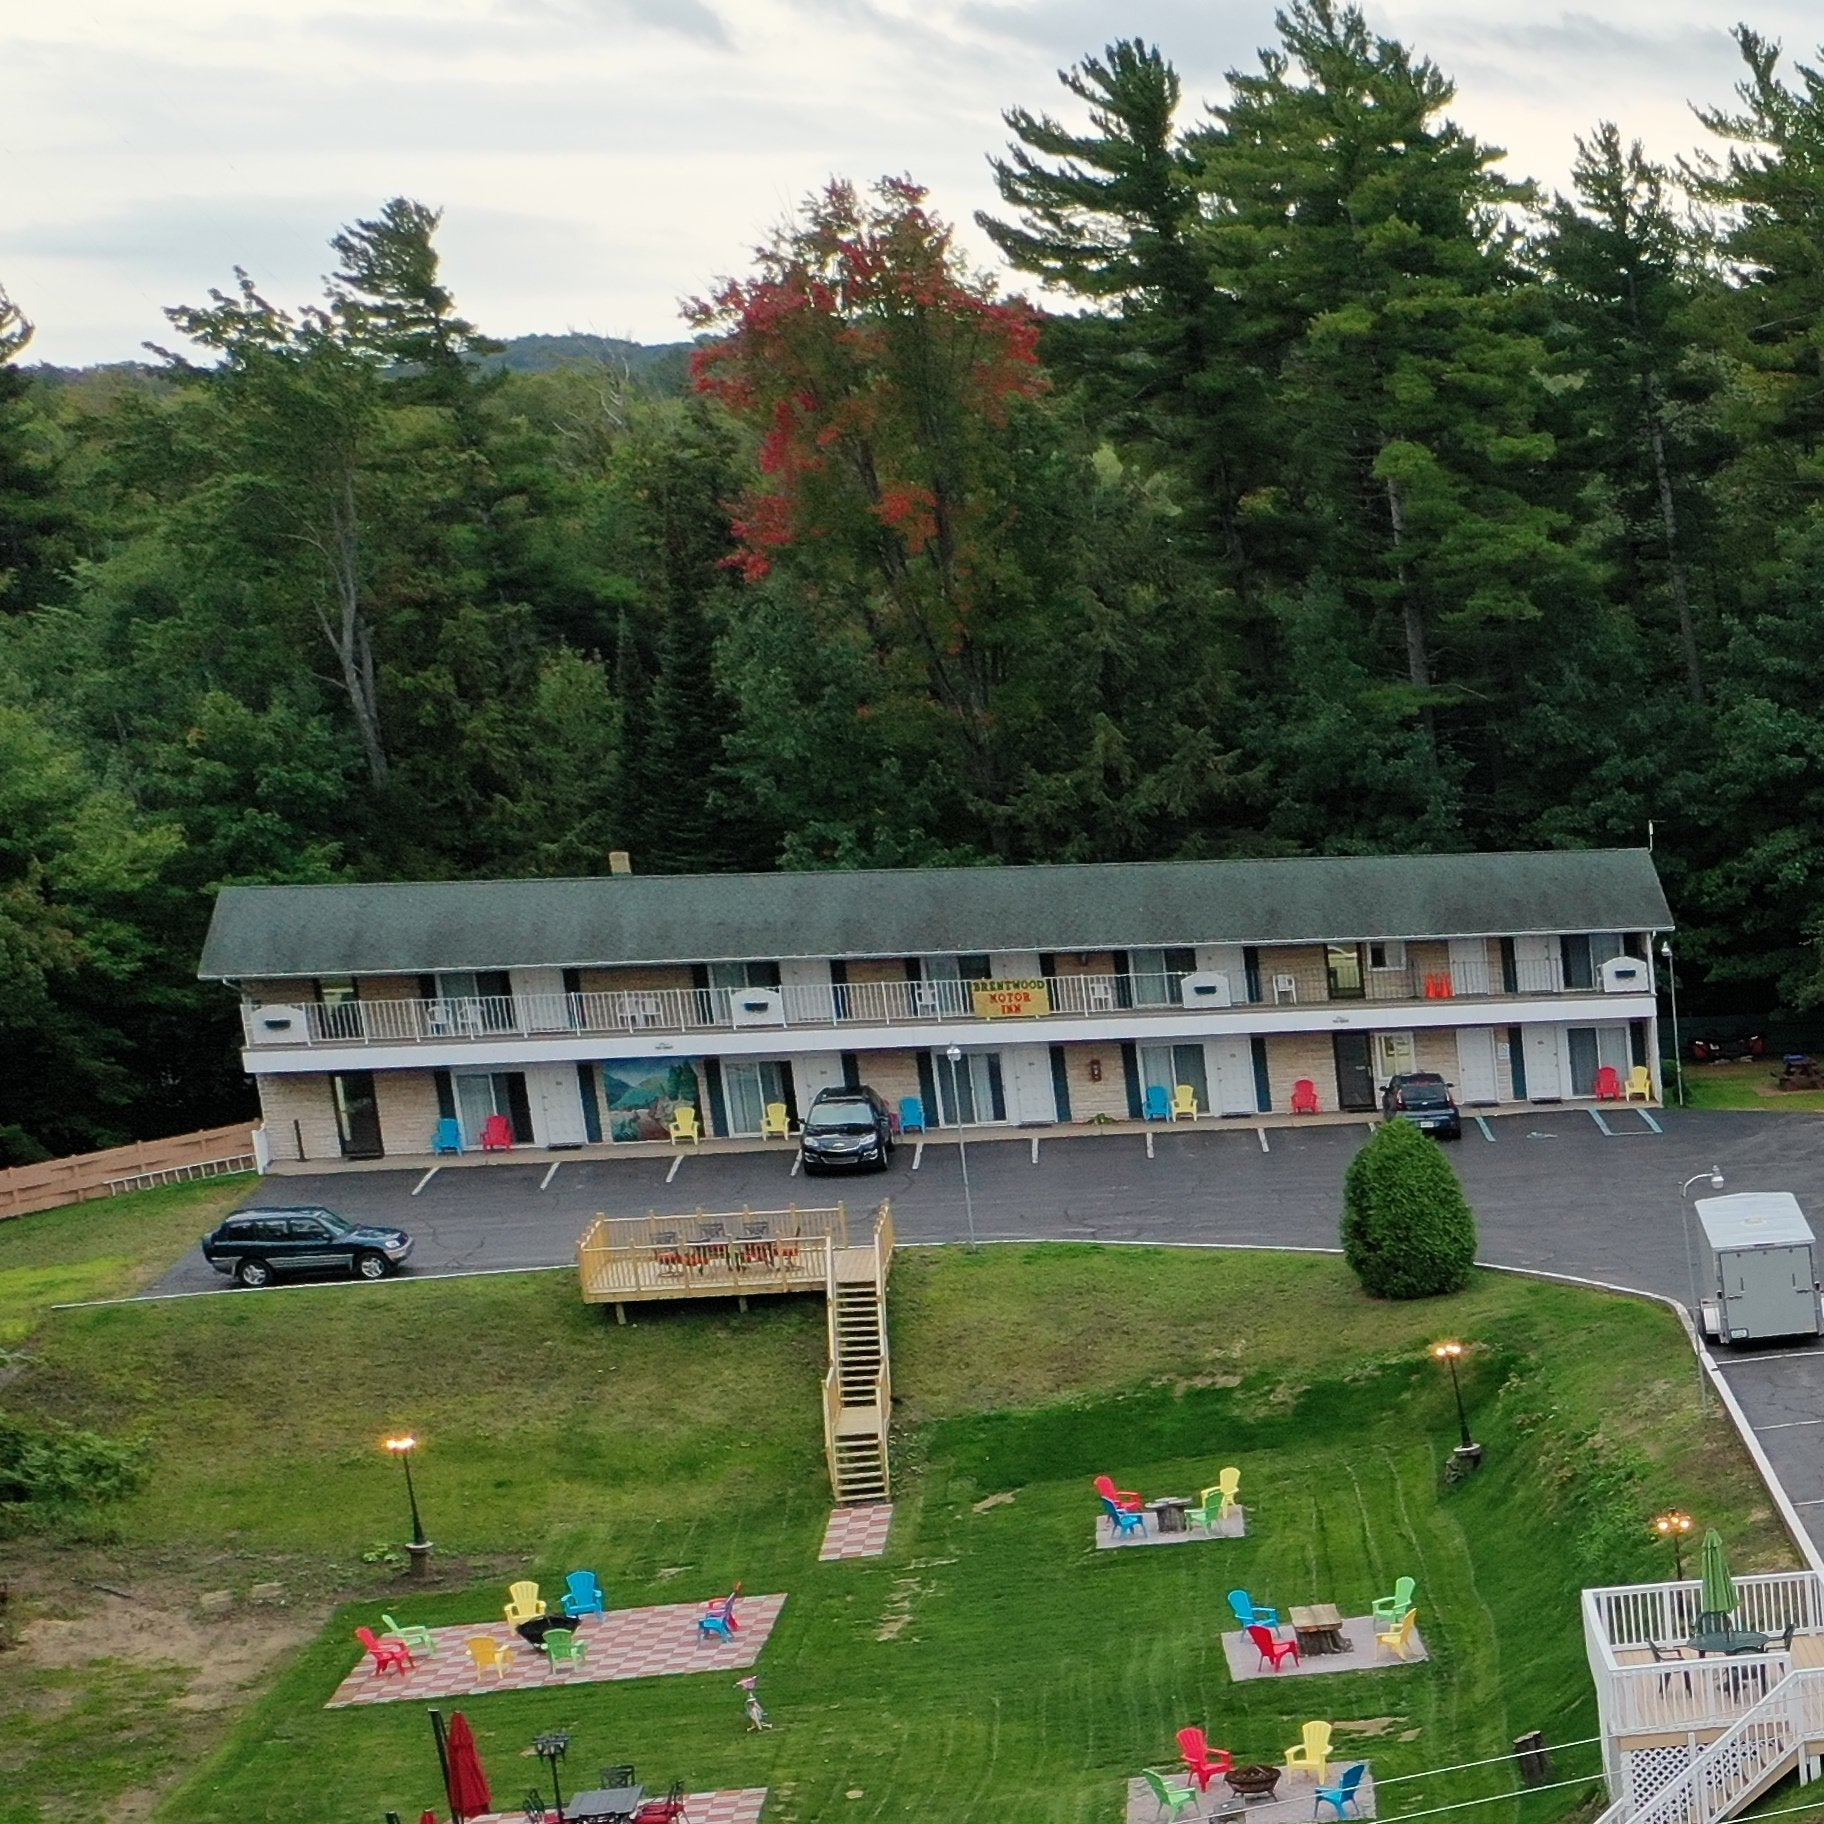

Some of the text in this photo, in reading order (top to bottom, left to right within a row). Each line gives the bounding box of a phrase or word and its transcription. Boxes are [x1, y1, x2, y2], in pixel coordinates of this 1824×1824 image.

[973, 980, 1045, 992] BRENTWOOD
[989, 992, 1031, 1003] MOTOR
[1001, 1004, 1021, 1014] INN
